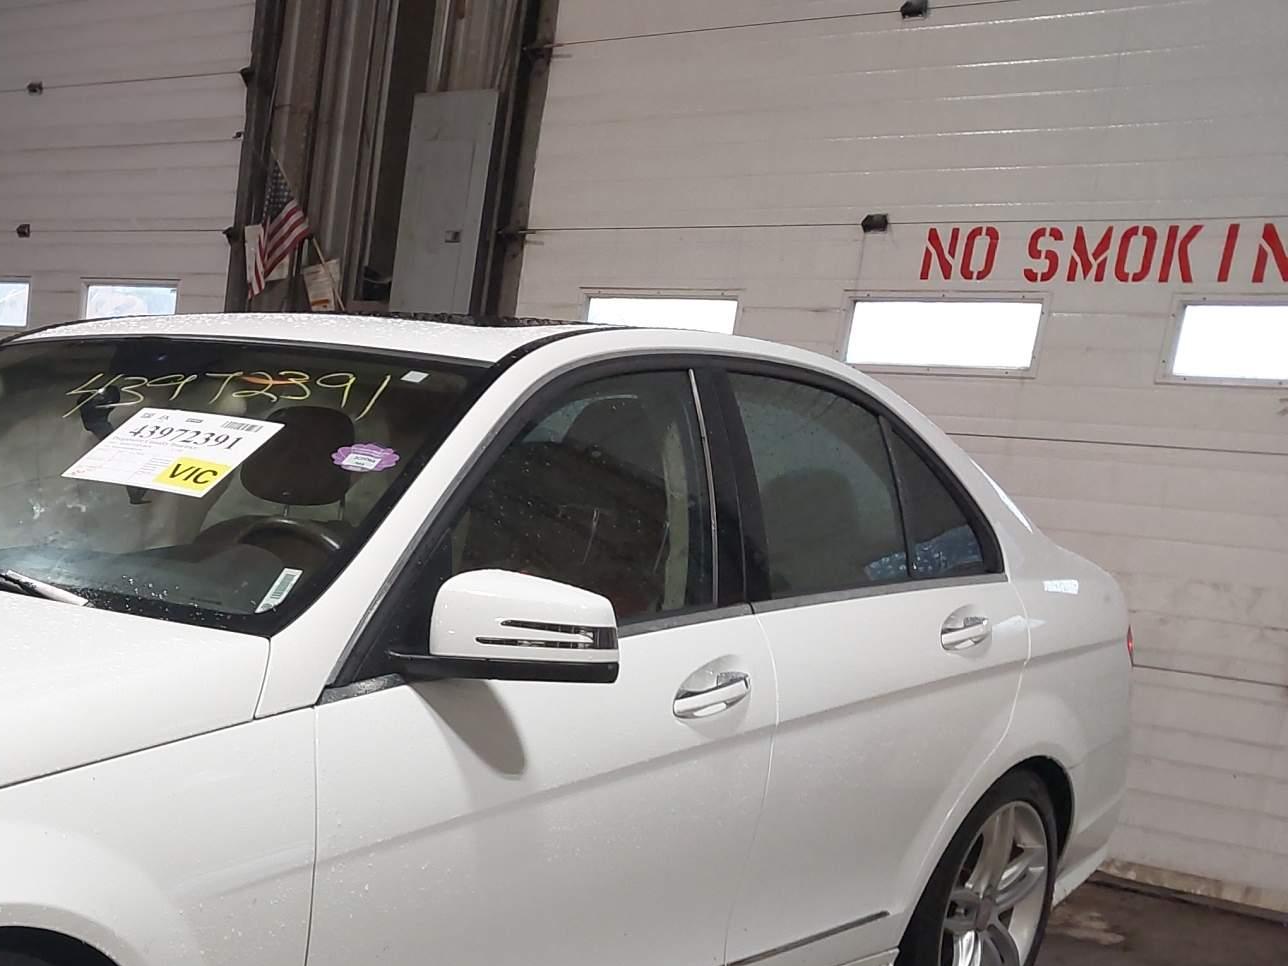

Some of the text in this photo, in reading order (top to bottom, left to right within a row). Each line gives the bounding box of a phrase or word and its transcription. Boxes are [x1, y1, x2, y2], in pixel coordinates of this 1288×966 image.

[919, 226, 1000, 281] NO
[62, 371, 391, 421] 43972391
[129, 424, 244, 449] 43972391
[168, 463, 219, 485] VIC
